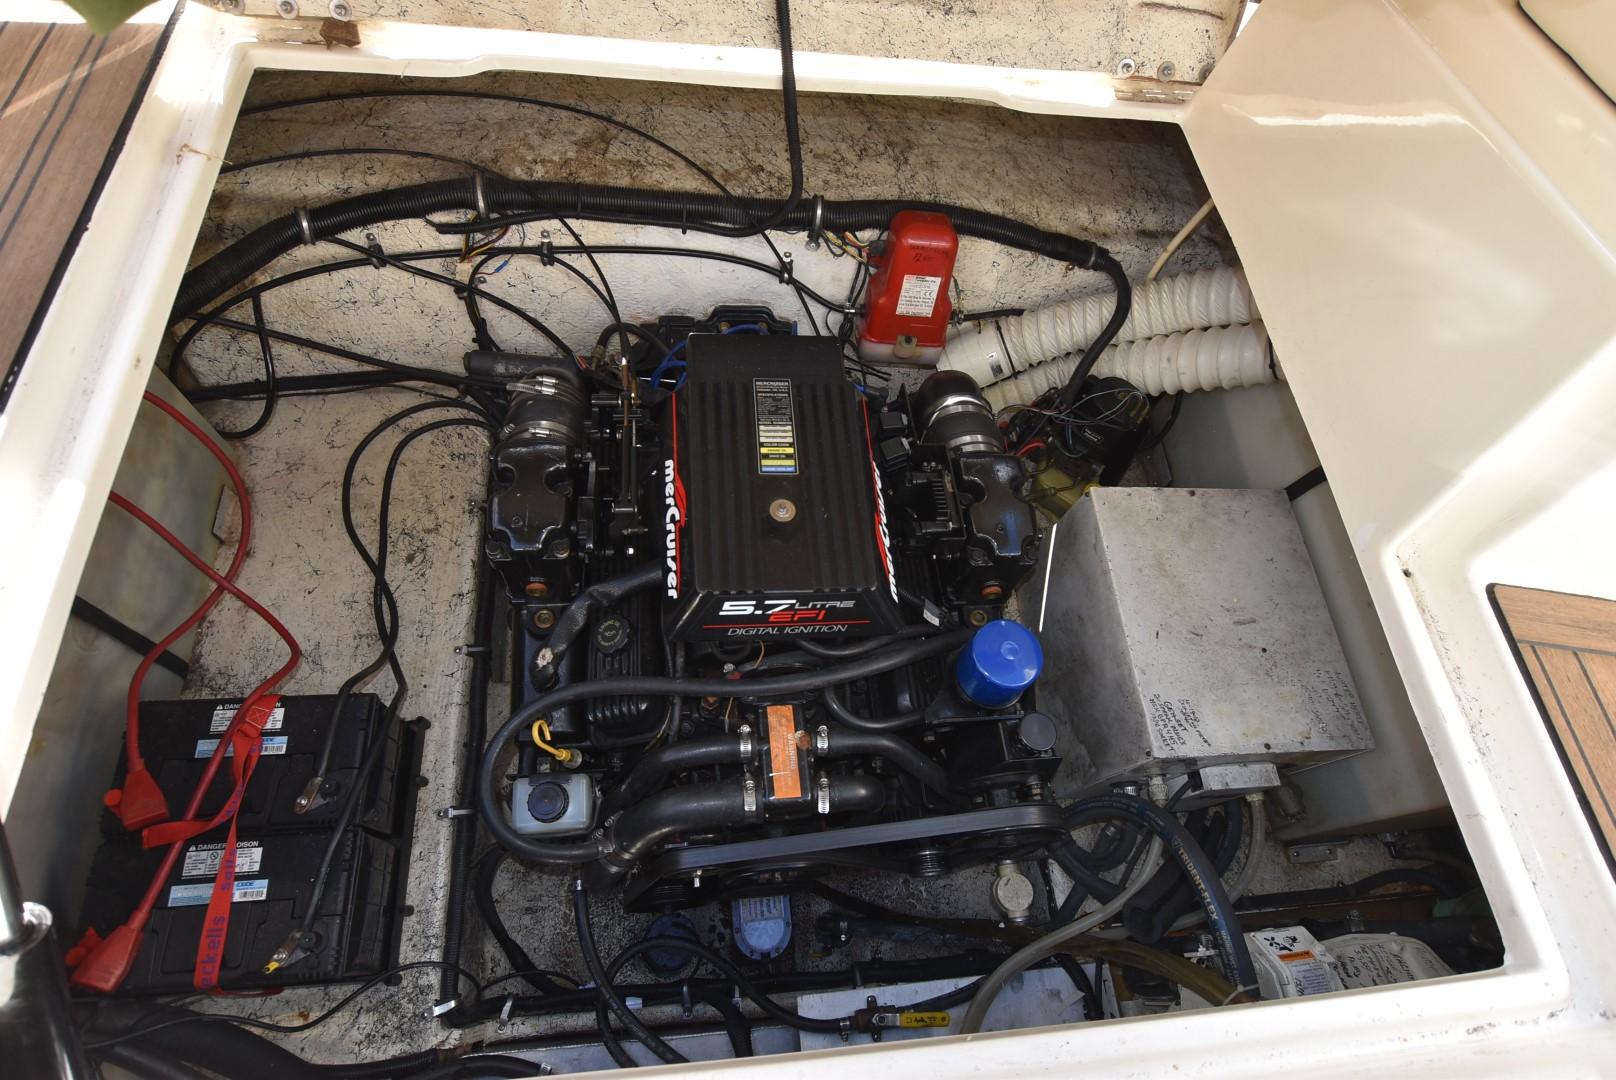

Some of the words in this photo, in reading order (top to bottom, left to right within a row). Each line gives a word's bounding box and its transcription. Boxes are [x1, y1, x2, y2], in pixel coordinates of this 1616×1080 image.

[719, 599, 797, 615] 5.7
[768, 609, 826, 622] EFI
[728, 626, 780, 636] DIGITAL
[783, 624, 848, 635] IGNITION
[236, 840, 259, 849] OISON
